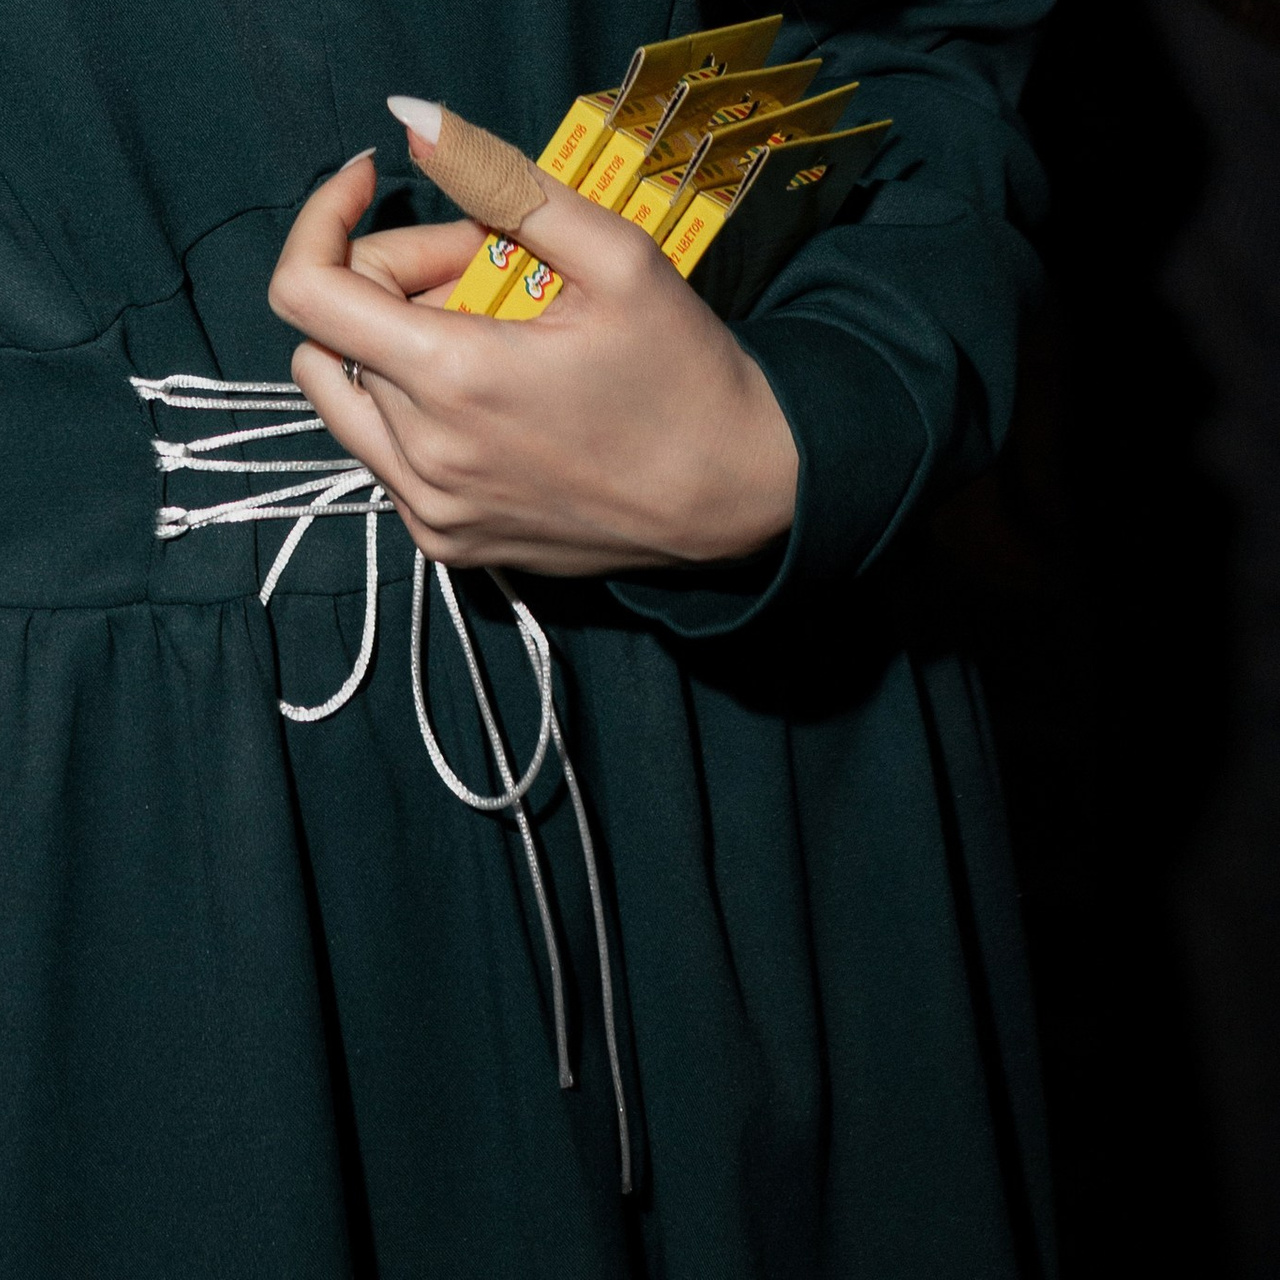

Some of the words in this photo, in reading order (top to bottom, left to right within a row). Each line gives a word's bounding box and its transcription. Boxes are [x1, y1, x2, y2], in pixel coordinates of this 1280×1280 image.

[551, 158, 564, 173] 12
[558, 123, 587, 161] ЦВЕТОВ
[596, 154, 625, 192] ЦВЕТОВ
[675, 217, 705, 255] ЦВЕТОВ
